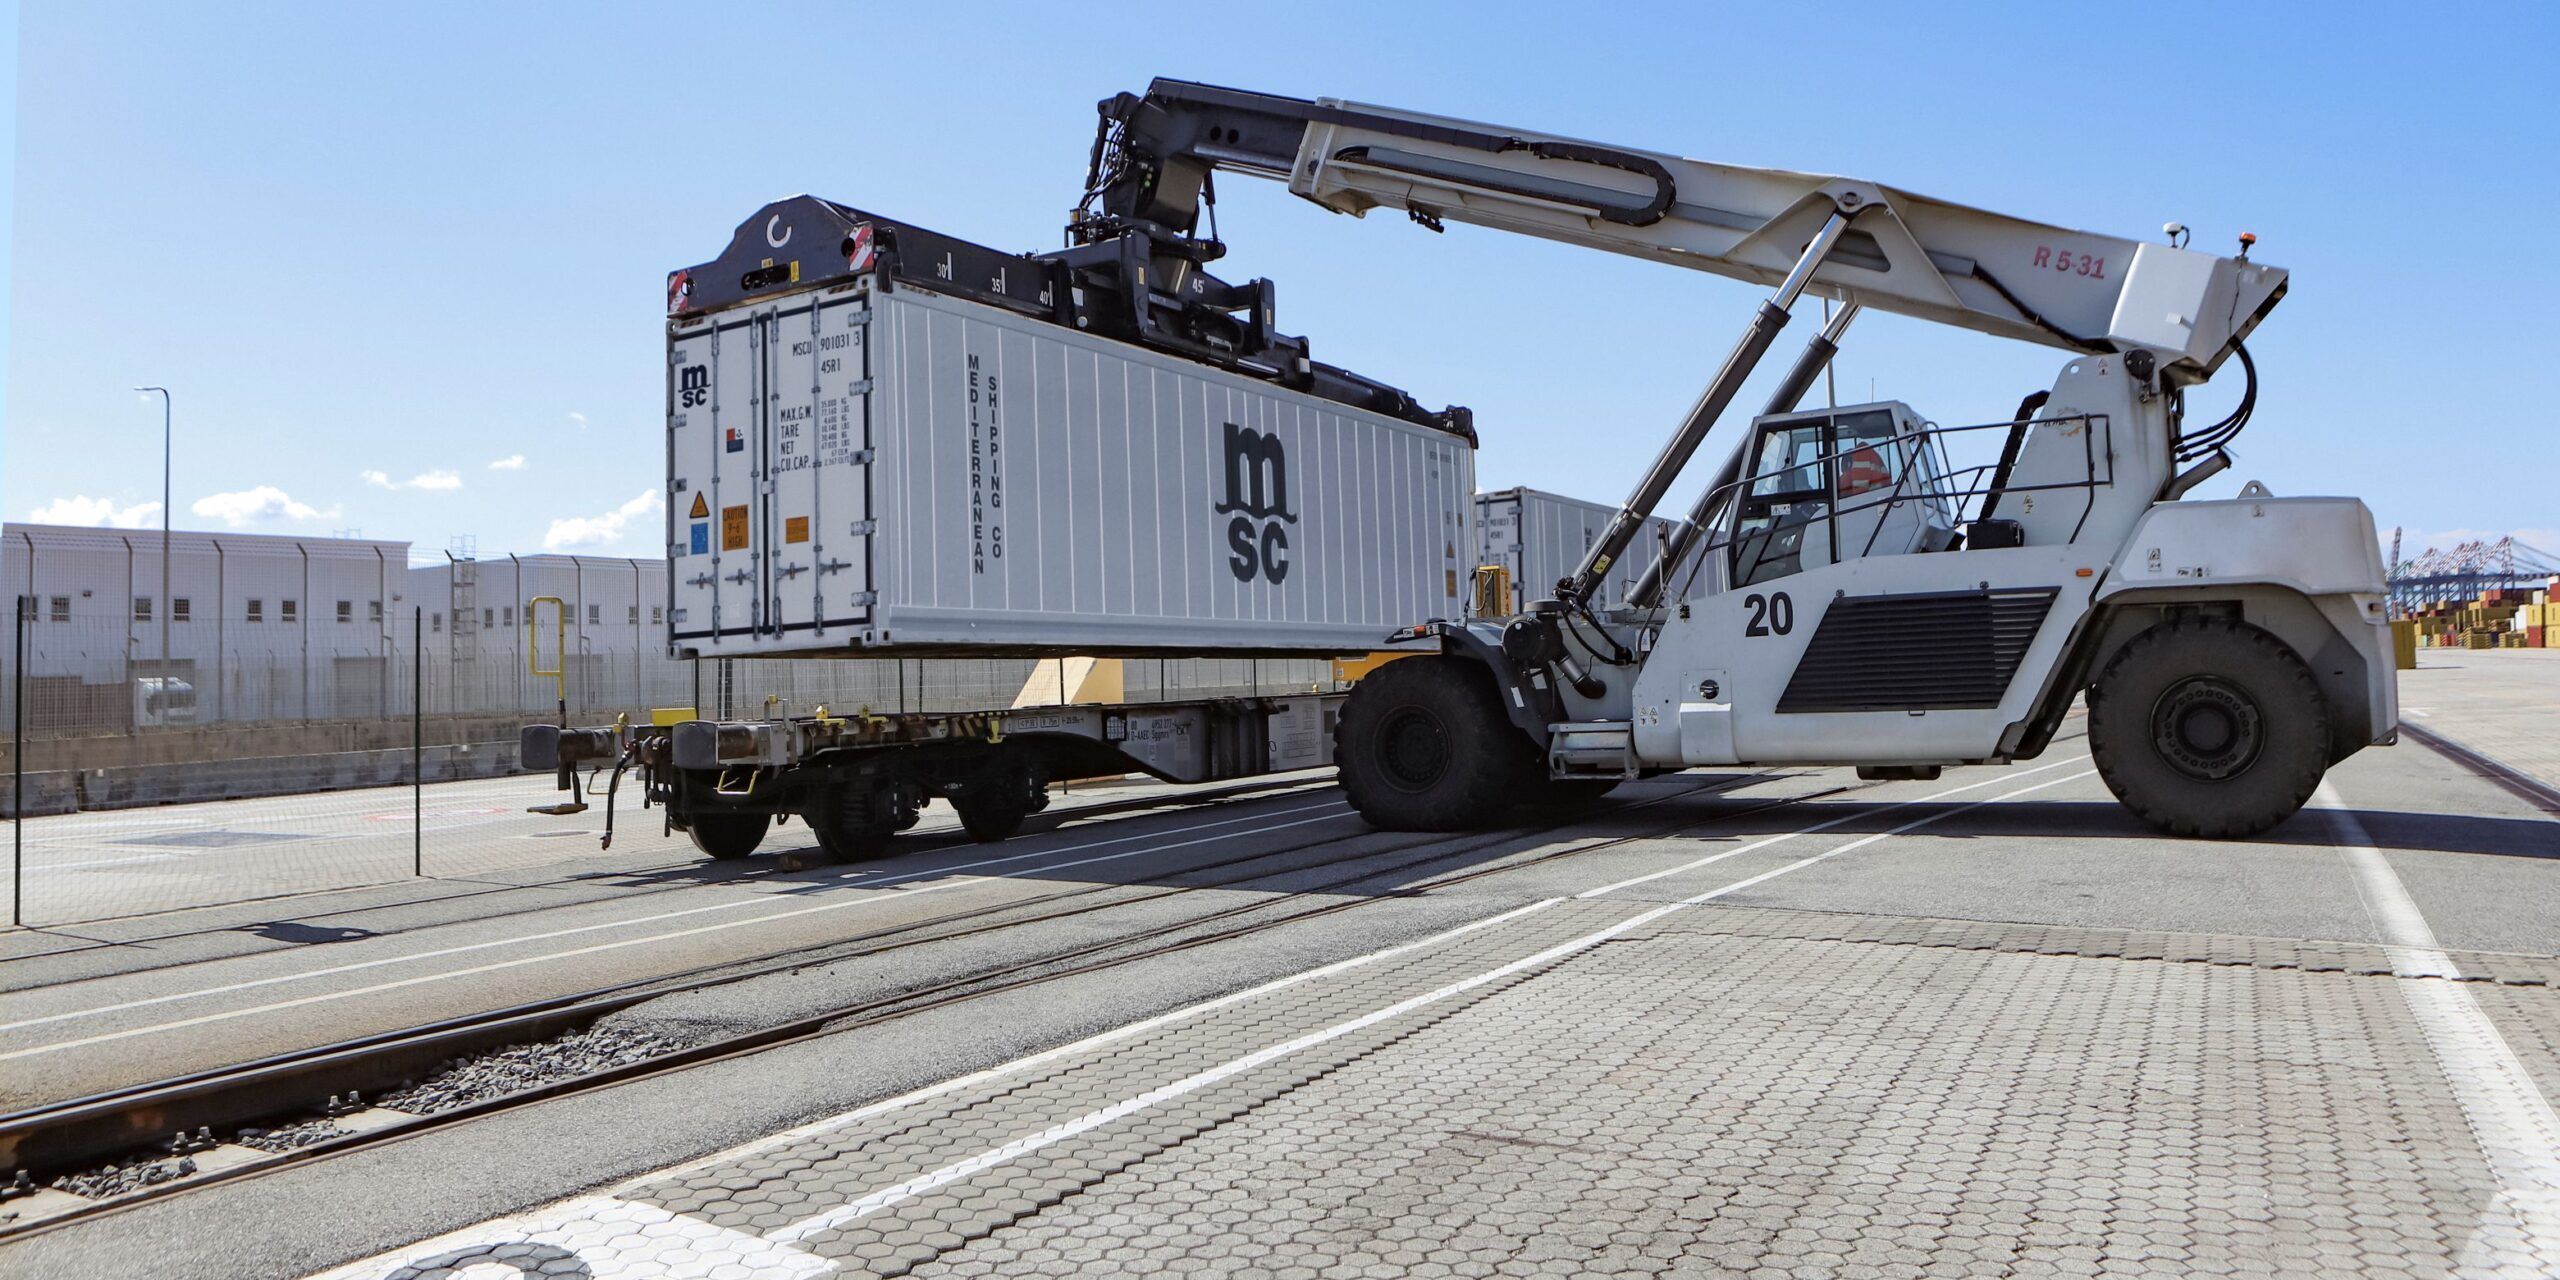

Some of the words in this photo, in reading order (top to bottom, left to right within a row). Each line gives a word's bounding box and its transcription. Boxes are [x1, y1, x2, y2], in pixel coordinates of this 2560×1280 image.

[2033, 246, 2052, 268] R
[2055, 251, 2105, 280] 5-31
[792, 340, 812, 356] MSCU
[820, 333, 849, 351] 901031
[854, 330, 860, 346] 3
[821, 358, 840, 374] 45R1
[780, 440, 794, 455] NET
[781, 423, 800, 440] TARE
[988, 376, 1001, 509] SHIPPING
[968, 354, 984, 574] MEDITERRANEAN
[992, 526, 1002, 558] CO
[1744, 591, 1794, 637] 20
